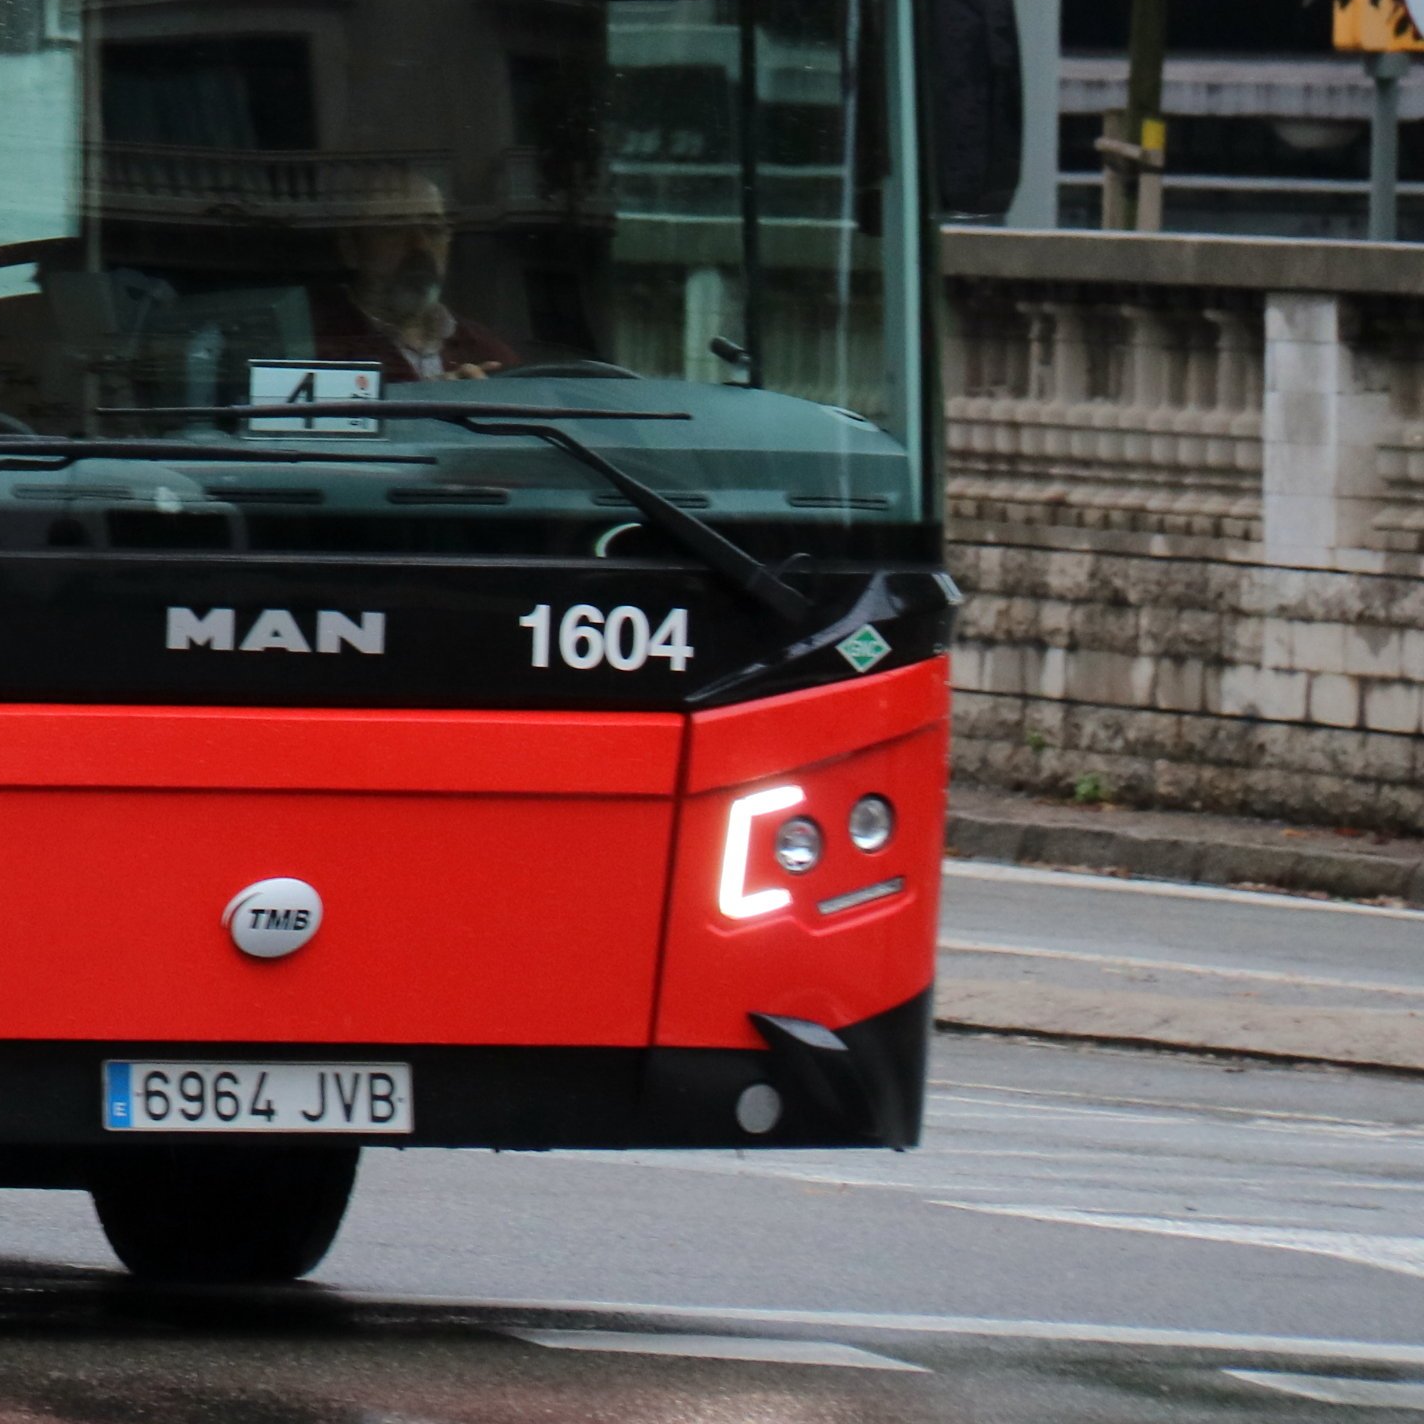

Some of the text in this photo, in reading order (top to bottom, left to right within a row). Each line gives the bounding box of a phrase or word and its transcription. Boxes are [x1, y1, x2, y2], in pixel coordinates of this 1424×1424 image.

[167, 607, 386, 654] MAN
[519, 604, 694, 672] 1604
[249, 909, 311, 931] TMB
[143, 1070, 397, 1124] 6964 JVB
